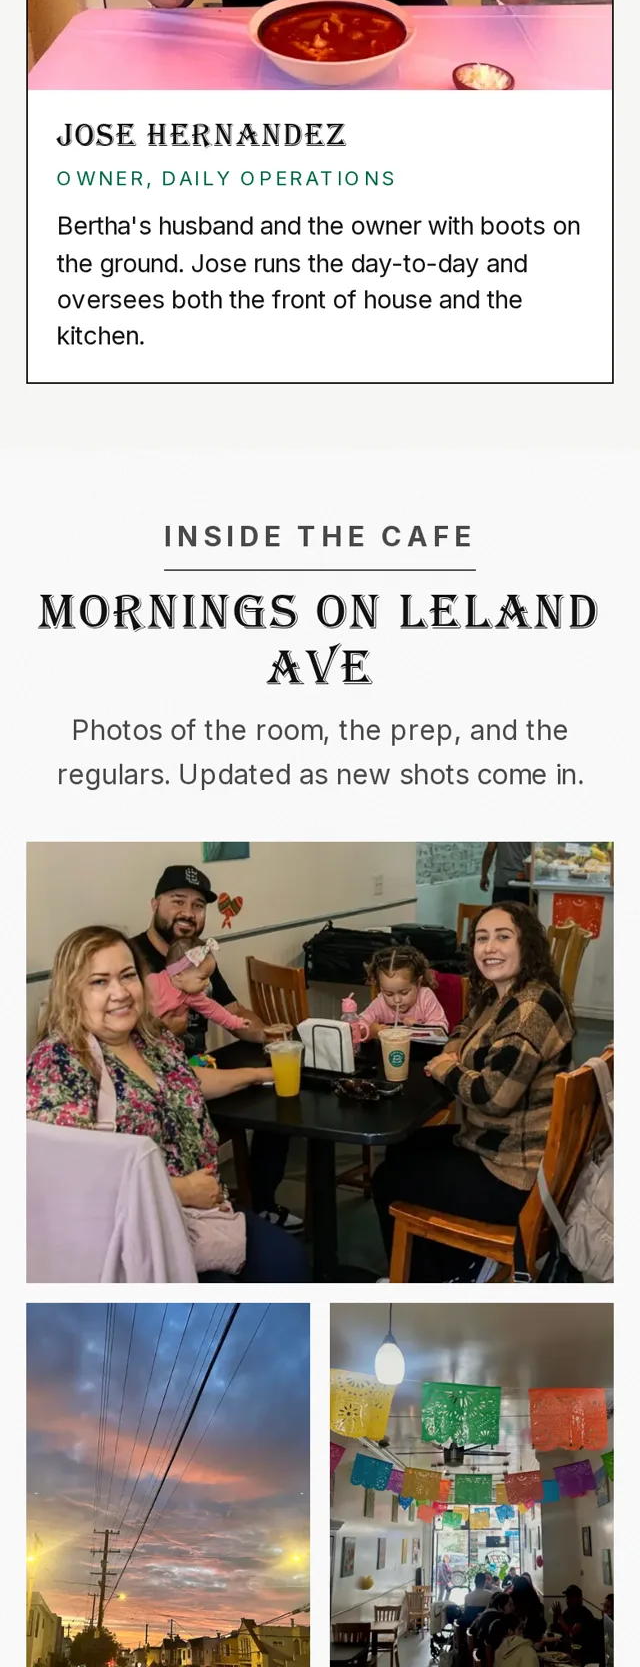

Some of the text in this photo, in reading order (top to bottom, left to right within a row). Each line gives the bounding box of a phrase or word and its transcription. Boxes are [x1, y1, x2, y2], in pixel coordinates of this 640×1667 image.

[56, 123, 346, 148] JOSE HERNANDEZ
[57, 171, 393, 189] OWNER, DAILY OPERATIONS
[58, 326, 144, 345] kitchen.
[165, 526, 470, 547] INSIDE THE CAFE
[38, 594, 598, 632] MORNINGS ON LELAND
[266, 643, 373, 685] AVE
